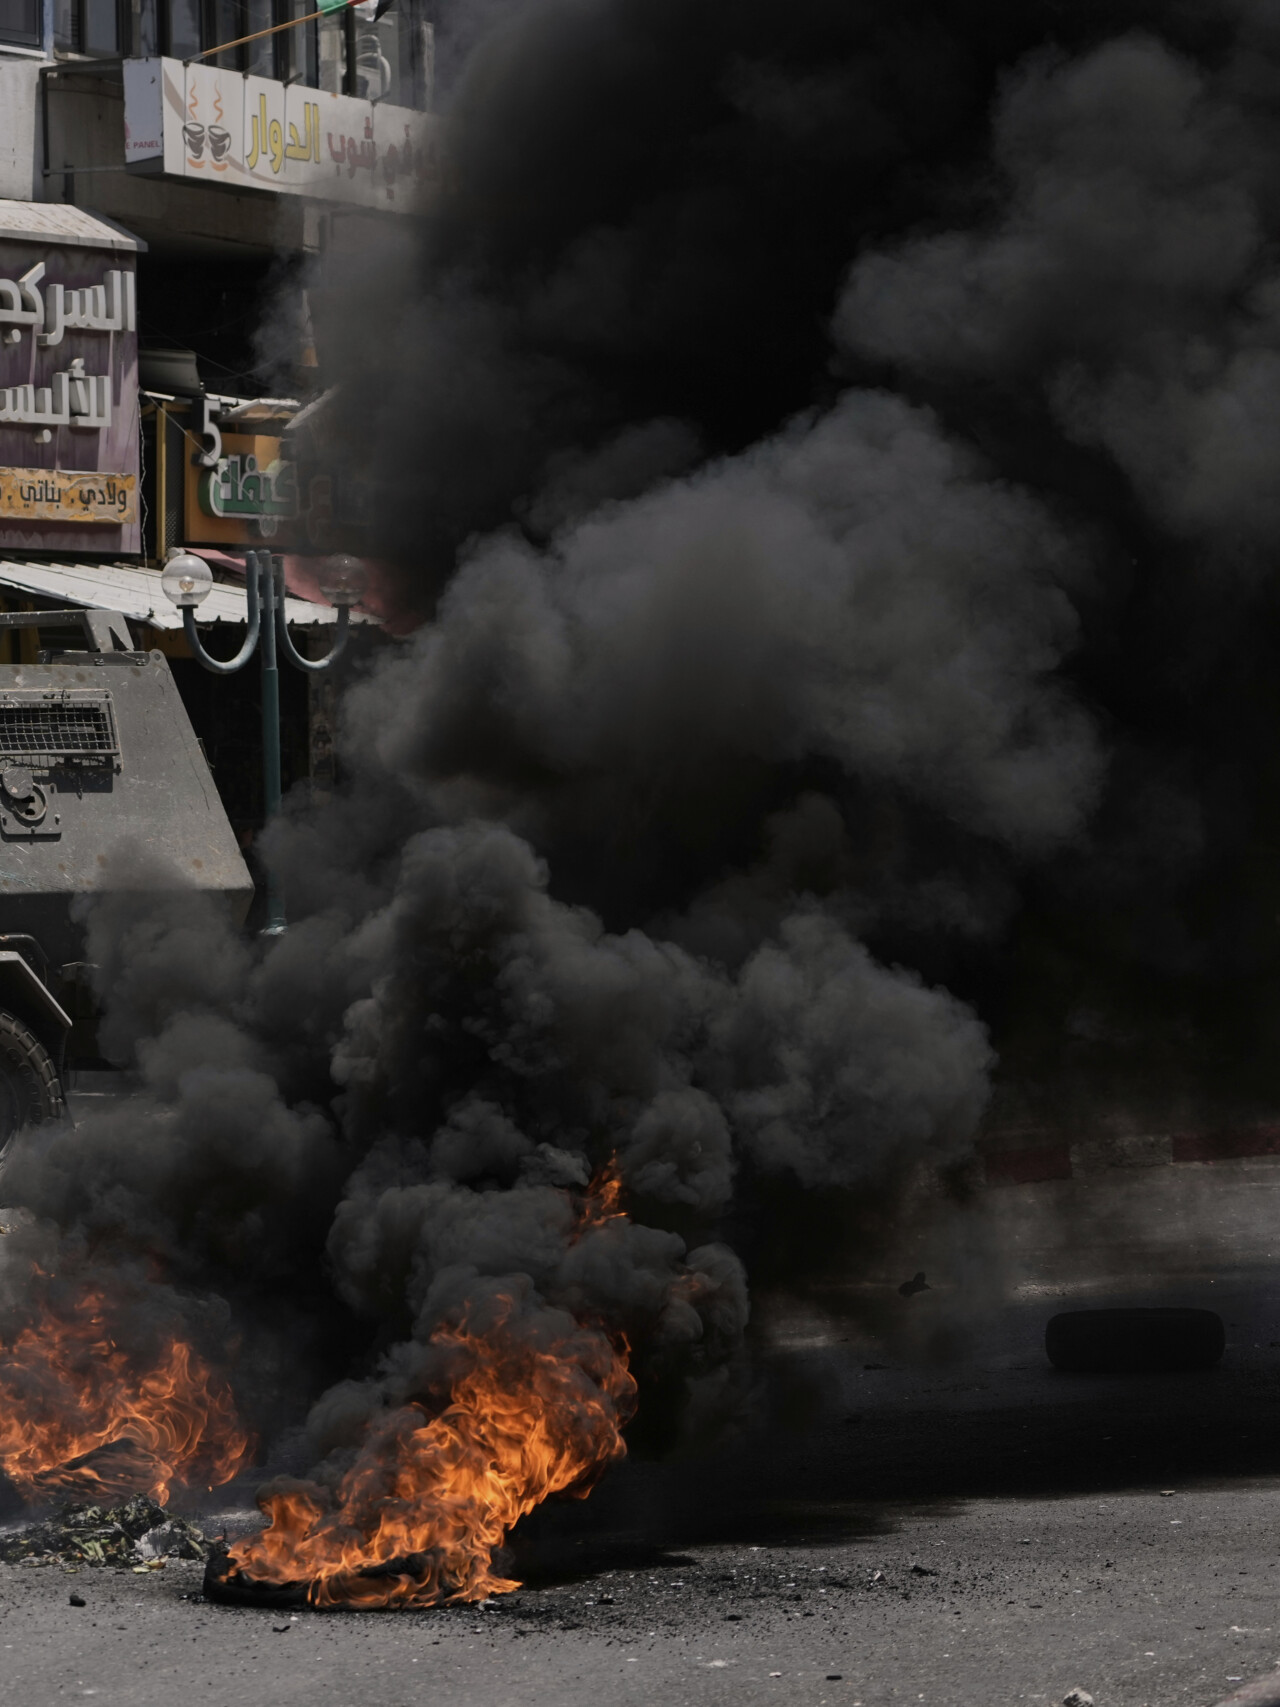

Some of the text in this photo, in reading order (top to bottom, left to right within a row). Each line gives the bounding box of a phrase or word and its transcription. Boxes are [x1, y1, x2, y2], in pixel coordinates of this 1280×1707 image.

[133, 140, 161, 149] PANEL
[246, 93, 320, 174] الدوار
[20, 479, 62, 508] بناتي
[79, 482, 128, 513] ولادي
